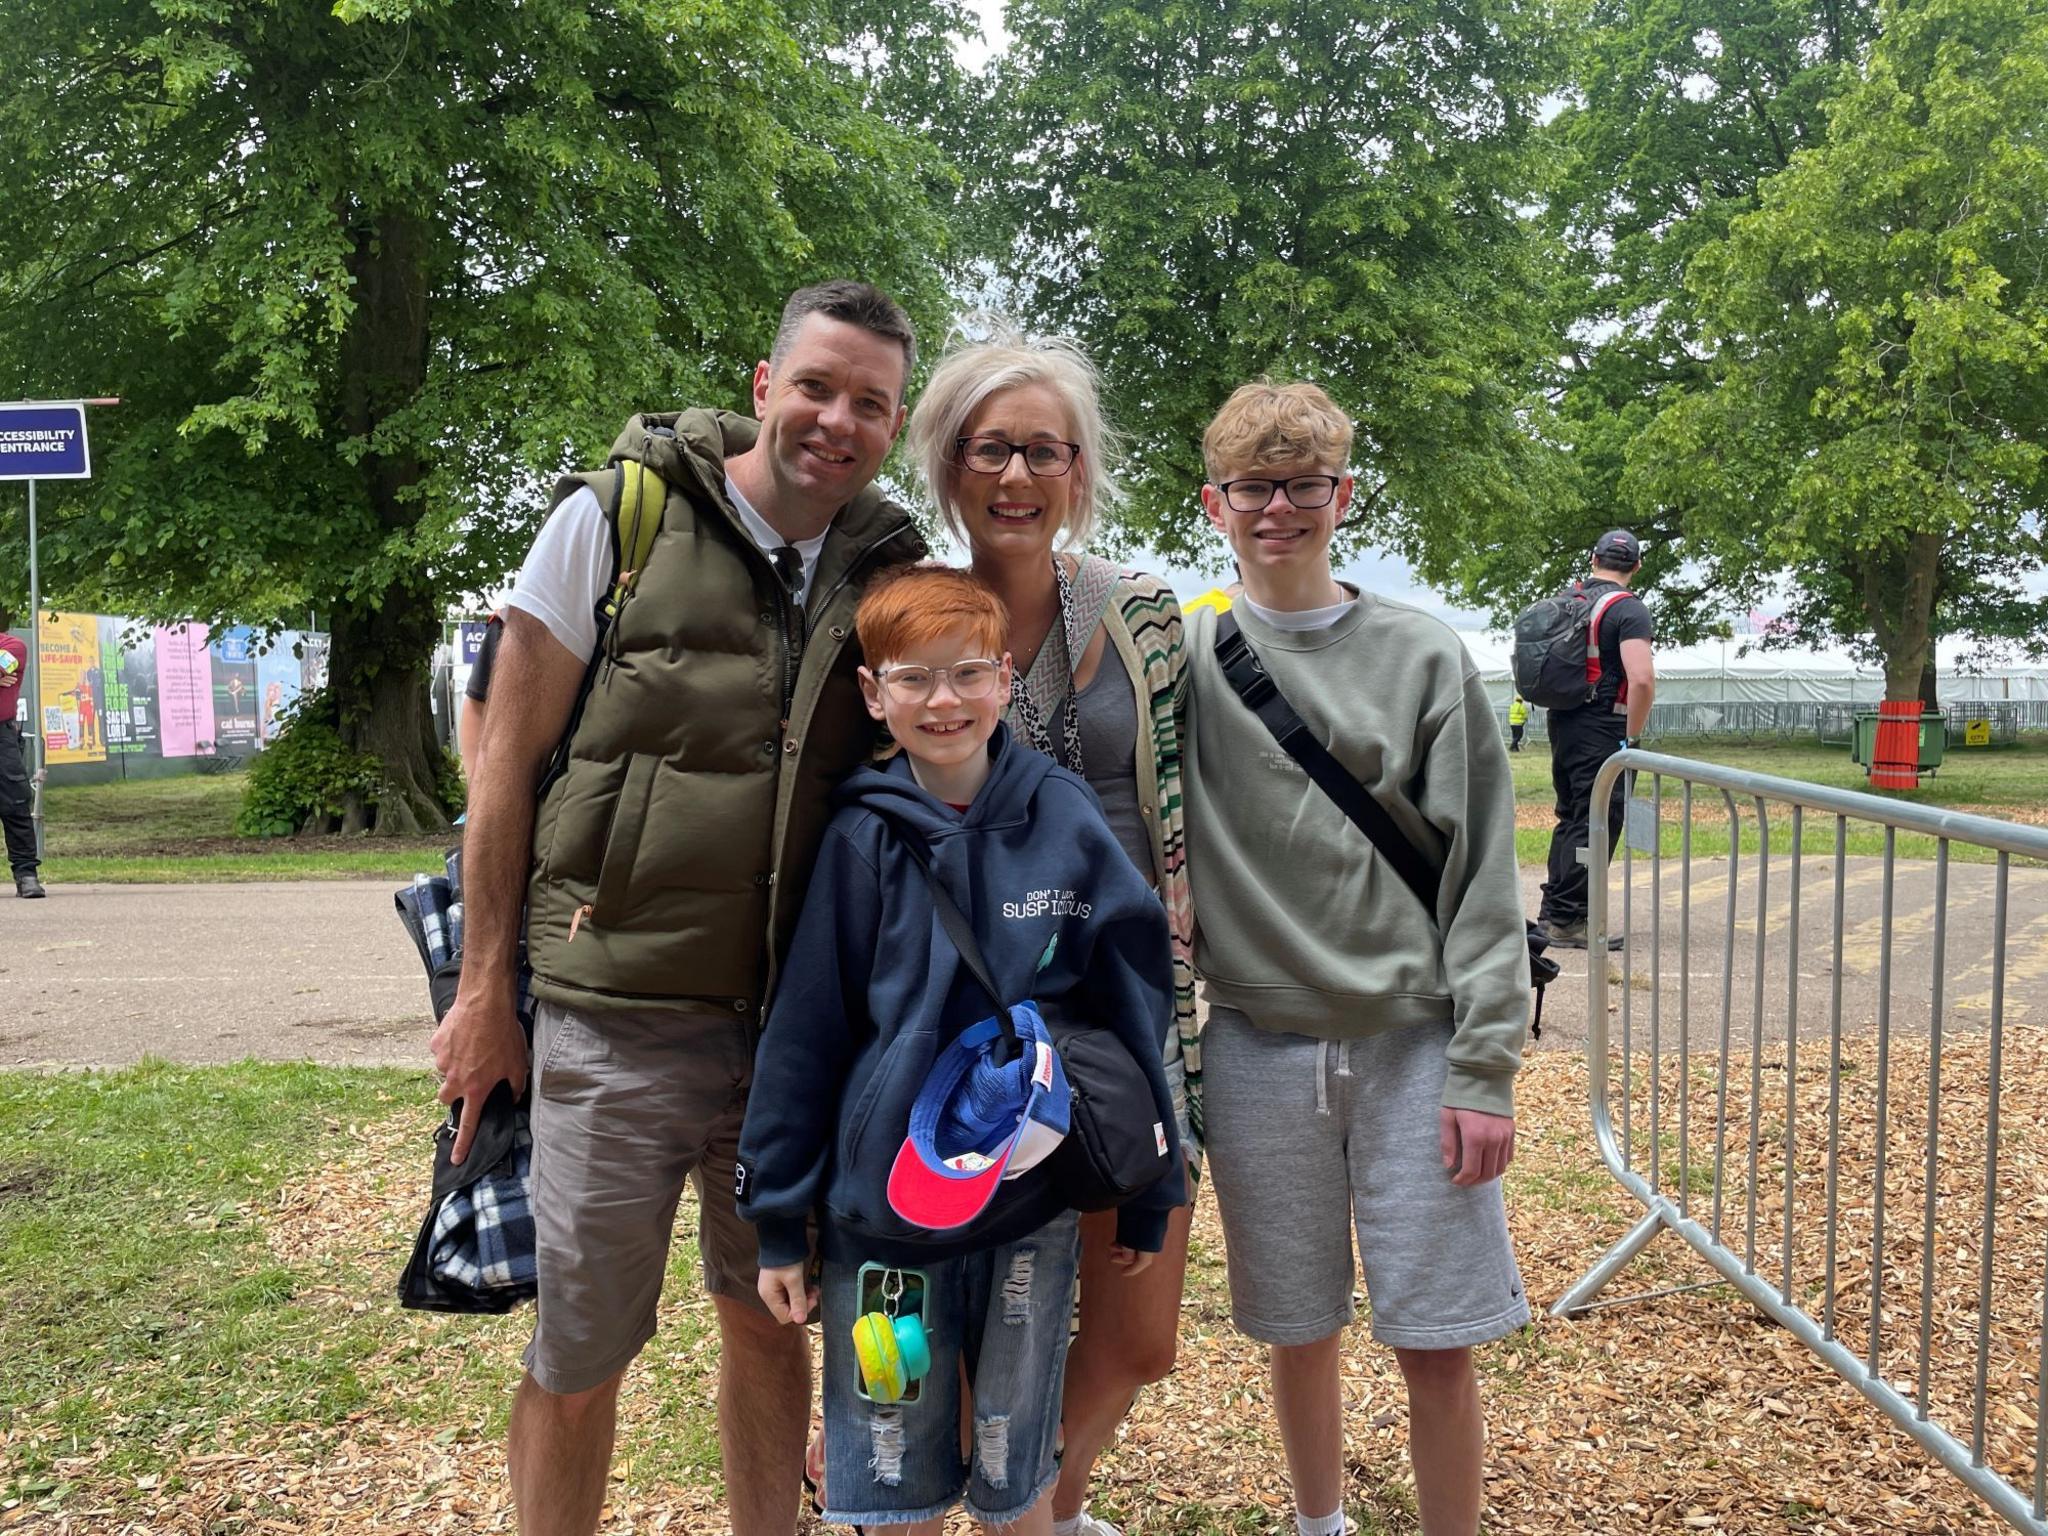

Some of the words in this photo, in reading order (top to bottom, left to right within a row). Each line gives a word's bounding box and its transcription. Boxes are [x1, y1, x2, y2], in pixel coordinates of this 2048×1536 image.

[0, 430, 75, 441] CCESSIBILITY
[0, 442, 65, 453] ENTRANCE
[104, 684, 129, 697] DANCE
[105, 697, 129, 710] FLOOR
[106, 711, 130, 724] SACHA
[107, 724, 127, 738] LORD
[1026, 889, 1060, 901] DON'T
[1003, 900, 1092, 919] SUSPICIOUS
